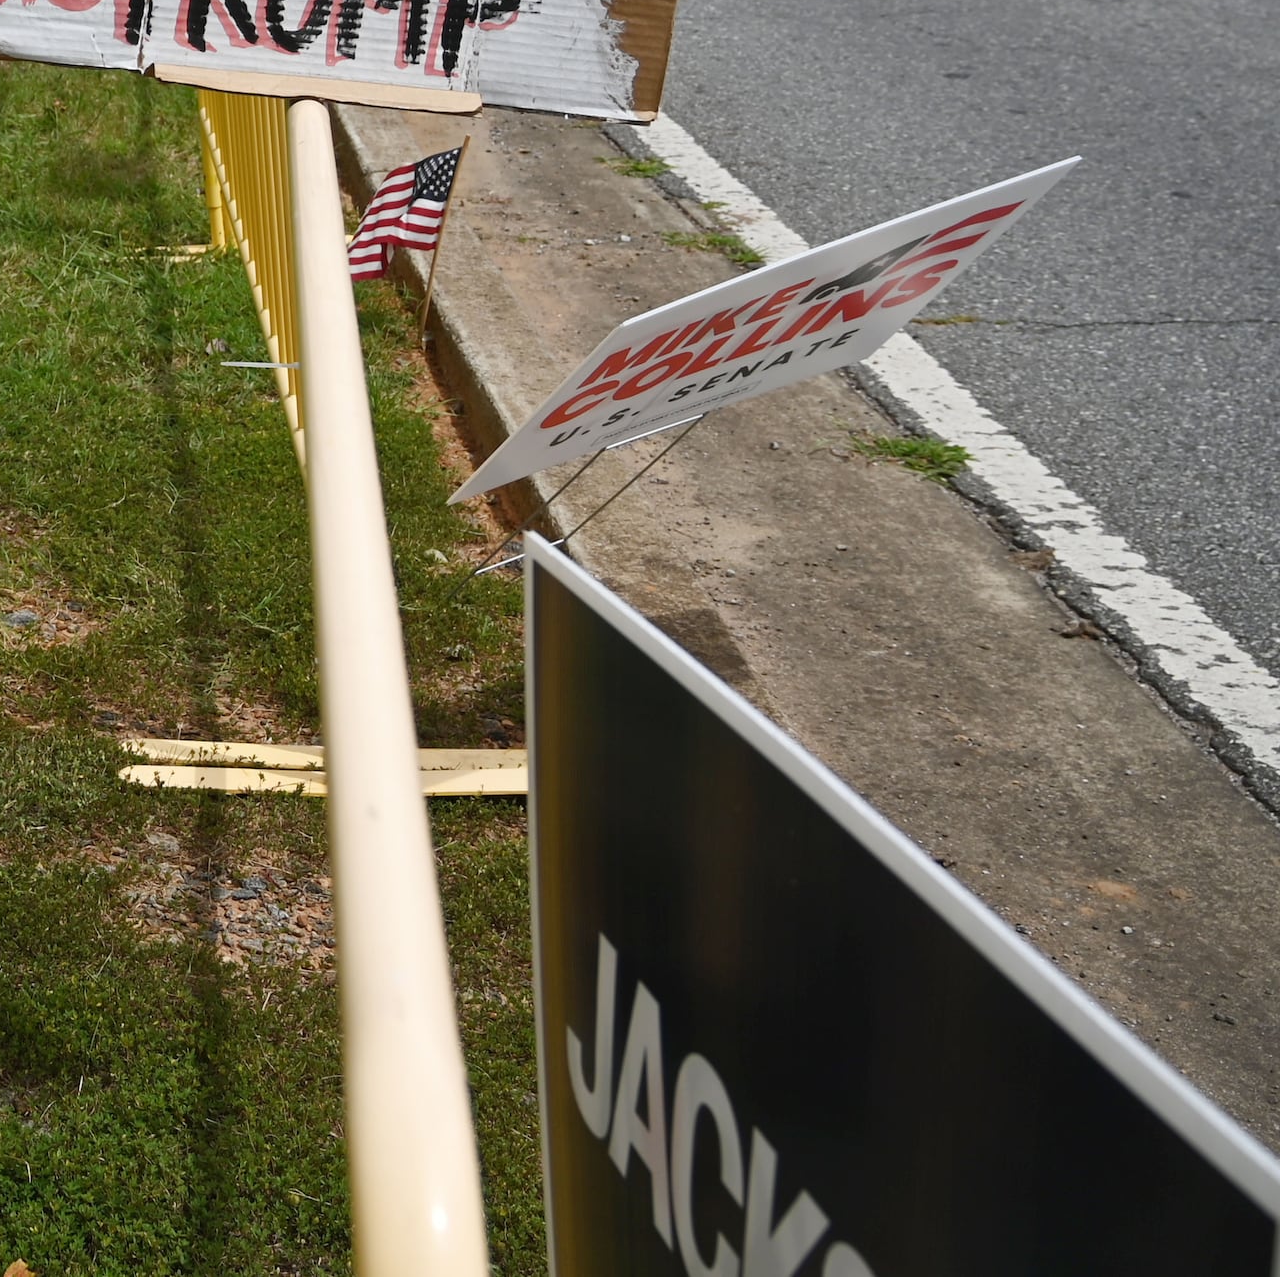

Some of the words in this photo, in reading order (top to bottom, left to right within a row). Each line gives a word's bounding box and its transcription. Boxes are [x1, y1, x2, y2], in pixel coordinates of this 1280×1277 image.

[540, 259, 958, 429] COLLINS
[579, 278, 816, 388] MIKE
[673, 328, 861, 402] SENATE
